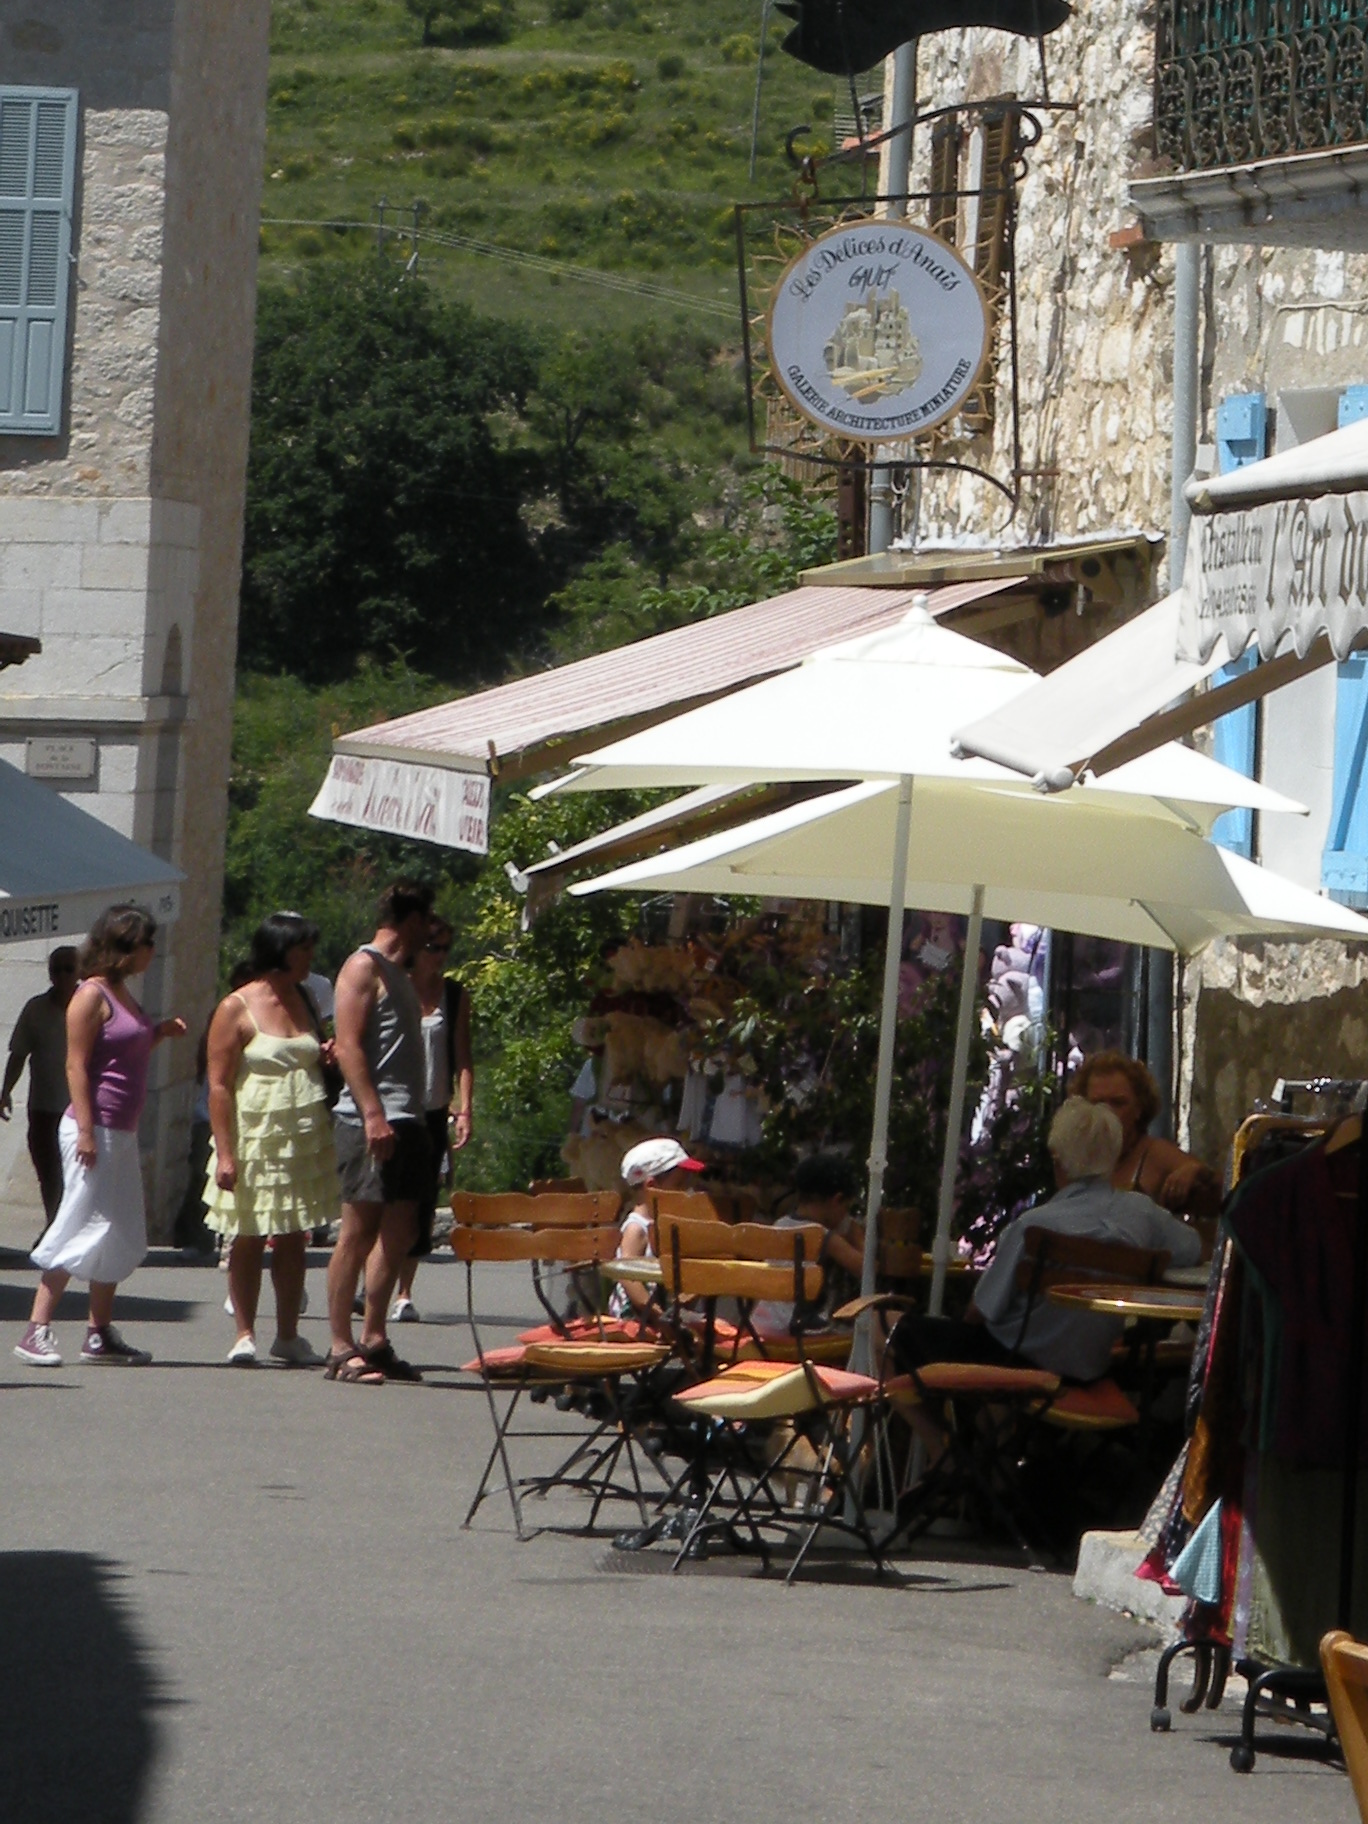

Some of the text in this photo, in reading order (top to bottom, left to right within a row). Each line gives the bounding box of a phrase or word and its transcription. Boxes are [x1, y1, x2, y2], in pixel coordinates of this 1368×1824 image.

[789, 266, 823, 303] Les
[815, 236, 886, 275] Délices
[787, 357, 973, 431] GALERIE ARCHITECTURE MINIATURE
